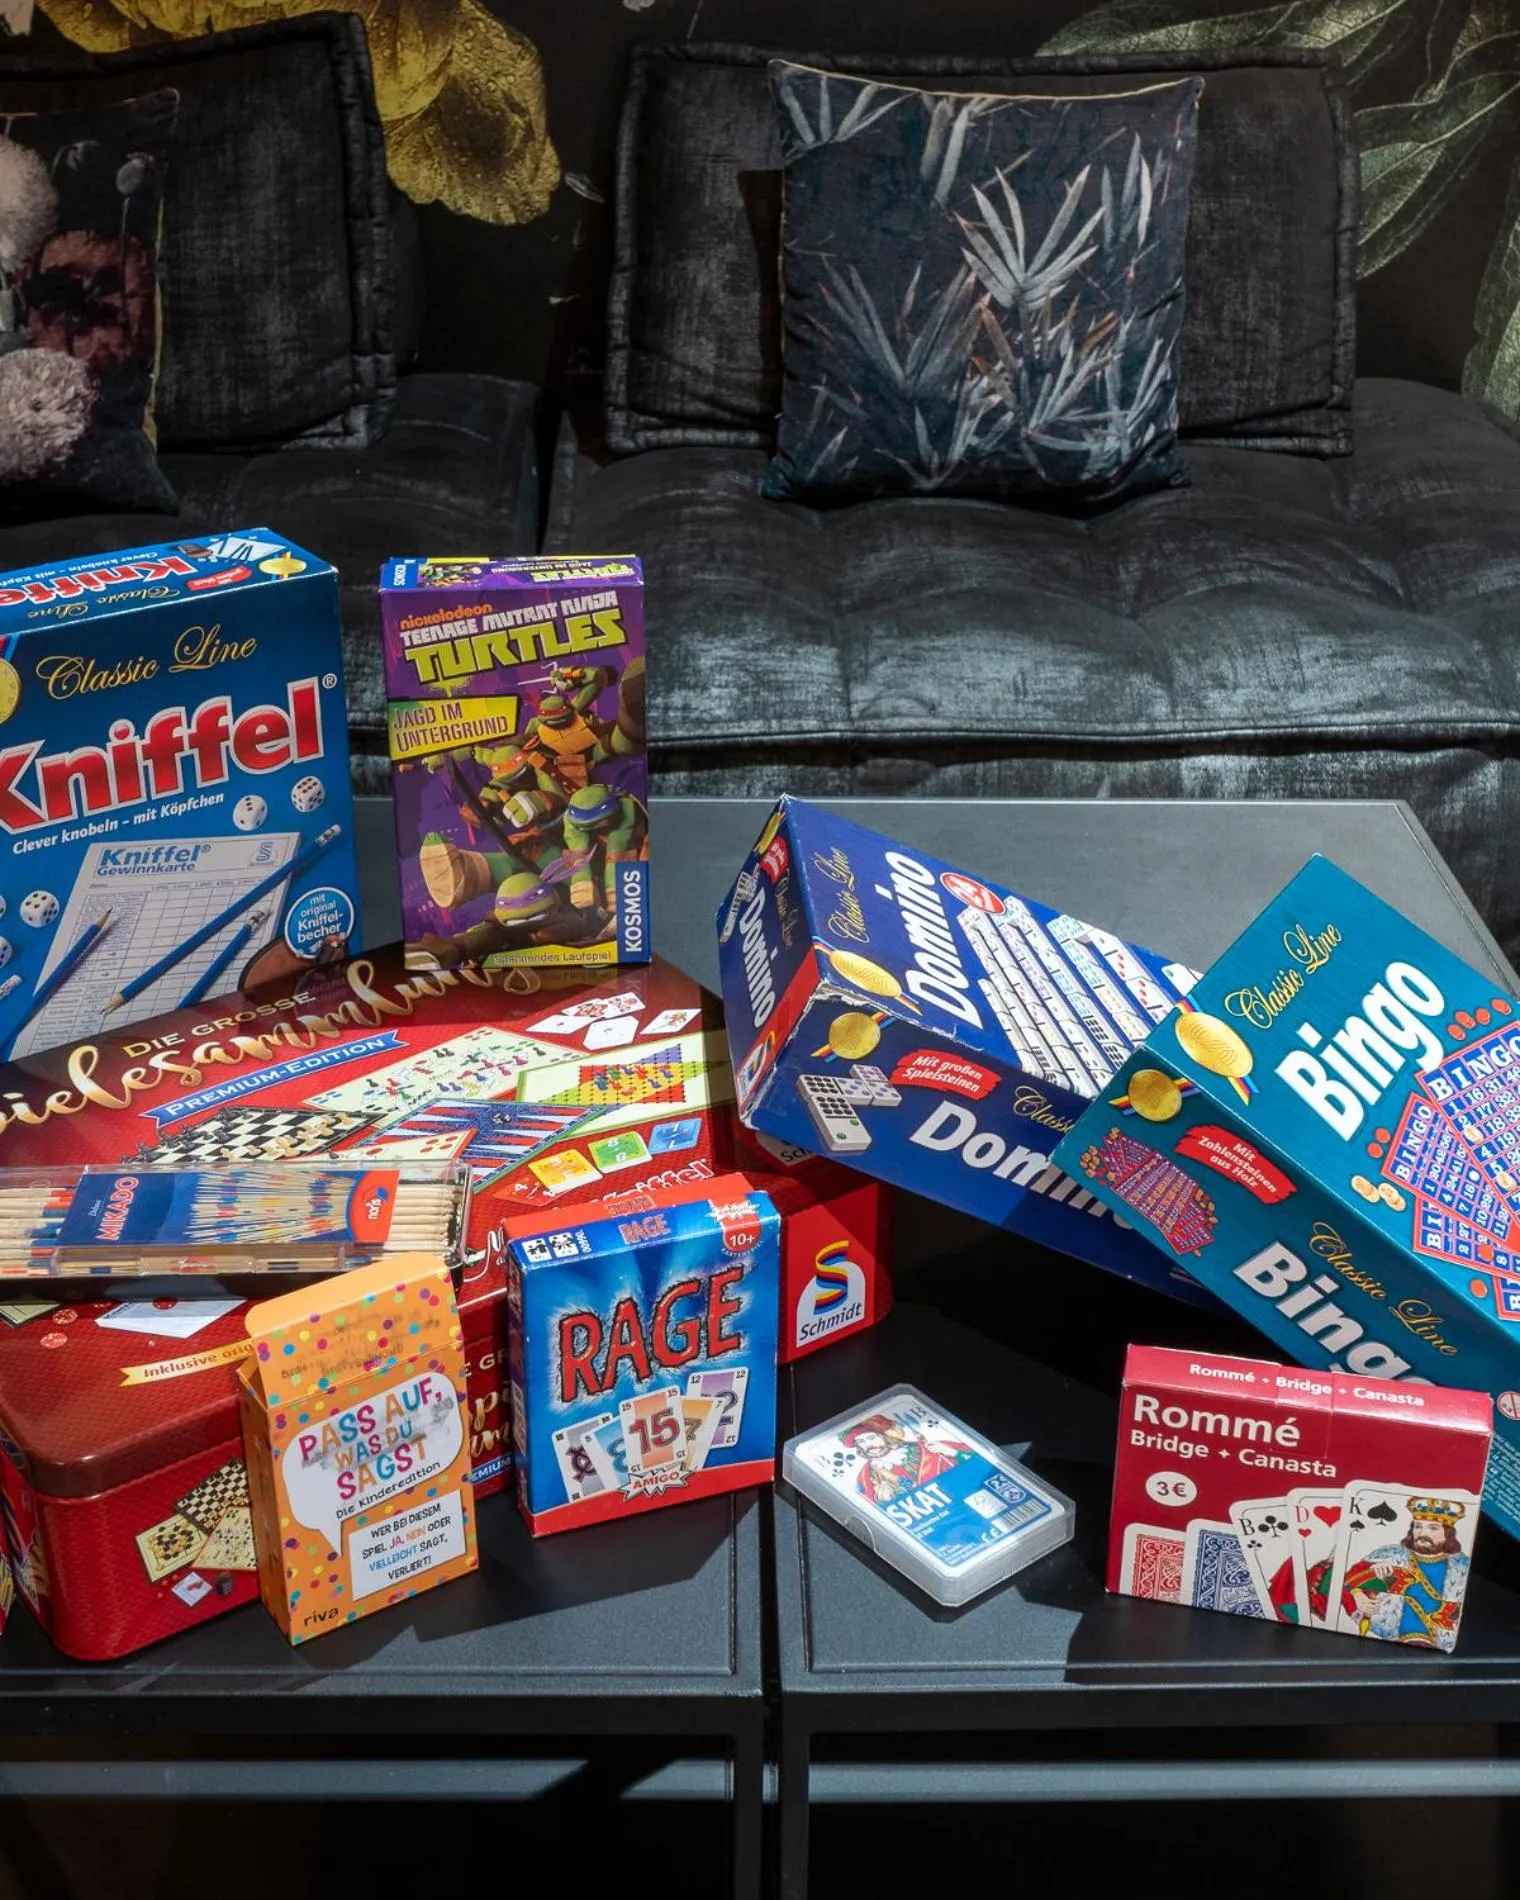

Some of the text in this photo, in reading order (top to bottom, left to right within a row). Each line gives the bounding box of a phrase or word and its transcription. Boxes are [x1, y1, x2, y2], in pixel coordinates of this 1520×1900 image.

[400, 603, 493, 630] nickelodeon
[400, 590, 619, 647] TEENAGE MUTANT NINJA
[36, 623, 257, 700] Classic Line
[405, 608, 626, 684] TURTLES
[393, 703, 463, 730] JAGD IM
[396, 715, 509, 752] UNTERGRUND
[12, 833, 59, 855] Clever
[61, 818, 119, 844] knobeln
[133, 808, 157, 826] mit
[160, 792, 225, 818] Köpfchen
[96, 862, 195, 877] Gewinnkarte
[300, 899, 336, 918] original
[309, 893, 325, 905] mit
[624, 870, 643, 953] KOSMOS
[814, 846, 870, 943] Classic Line
[297, 923, 342, 944] becher
[298, 910, 344, 932] Kniffel-
[875, 851, 984, 1030] Domino
[494, 950, 612, 966] Spannendes Laufspiel
[739, 887, 778, 1028] Domino
[1224, 923, 1342, 1029] Classic Line
[125, 991, 317, 1059] DIE GROSSE
[912, 1056, 982, 1080] Mit großen
[1274, 961, 1445, 1141] Bingo
[164, 1037, 386, 1116] PREMIUM-EDITION
[902, 1067, 980, 1093] Spielsteinen
[1198, 1135, 1277, 1193] Zahlensteinen
[1210, 1155, 1259, 1188] aus Holz
[1233, 1143, 1256, 1162] Mit
[95, 1176, 139, 1240] MIKADO
[619, 1213, 671, 1245] RAGE
[729, 1232, 756, 1247] 10+
[1309, 1222, 1387, 1300] Classic
[1388, 1300, 1457, 1356] Line
[557, 1264, 746, 1403] RAGE
[800, 1301, 862, 1341] Schmidt
[143, 1351, 218, 1378] Inklusive
[1189, 1363, 1425, 1408] Rommé Bridge Canasta
[299, 1405, 376, 1462] PASS
[385, 1376, 444, 1420] AUF,
[629, 1407, 681, 1453] 15
[1133, 1394, 1302, 1448] Rommé
[335, 1419, 414, 1470] WAS DU
[337, 1433, 427, 1501] SAGST
[1129, 1429, 1338, 1479] Bridge Canasta
[335, 1461, 441, 1520] Die Kinderedition
[632, 1471, 681, 1490] AMIGO
[371, 1502, 442, 1539] WER BEI DIESEM
[886, 1482, 953, 1529] SKAT
[1239, 1518, 1256, 1536] B
[1295, 1505, 1310, 1524] D
[1348, 1496, 1365, 1516] K
[361, 1543, 387, 1560] SPIEL
[427, 1515, 452, 1532] ODER
[369, 1533, 448, 1572] VIELLEICHT SAGT,
[387, 1555, 432, 1580] VERLIERT!
[303, 1605, 340, 1628] riva
